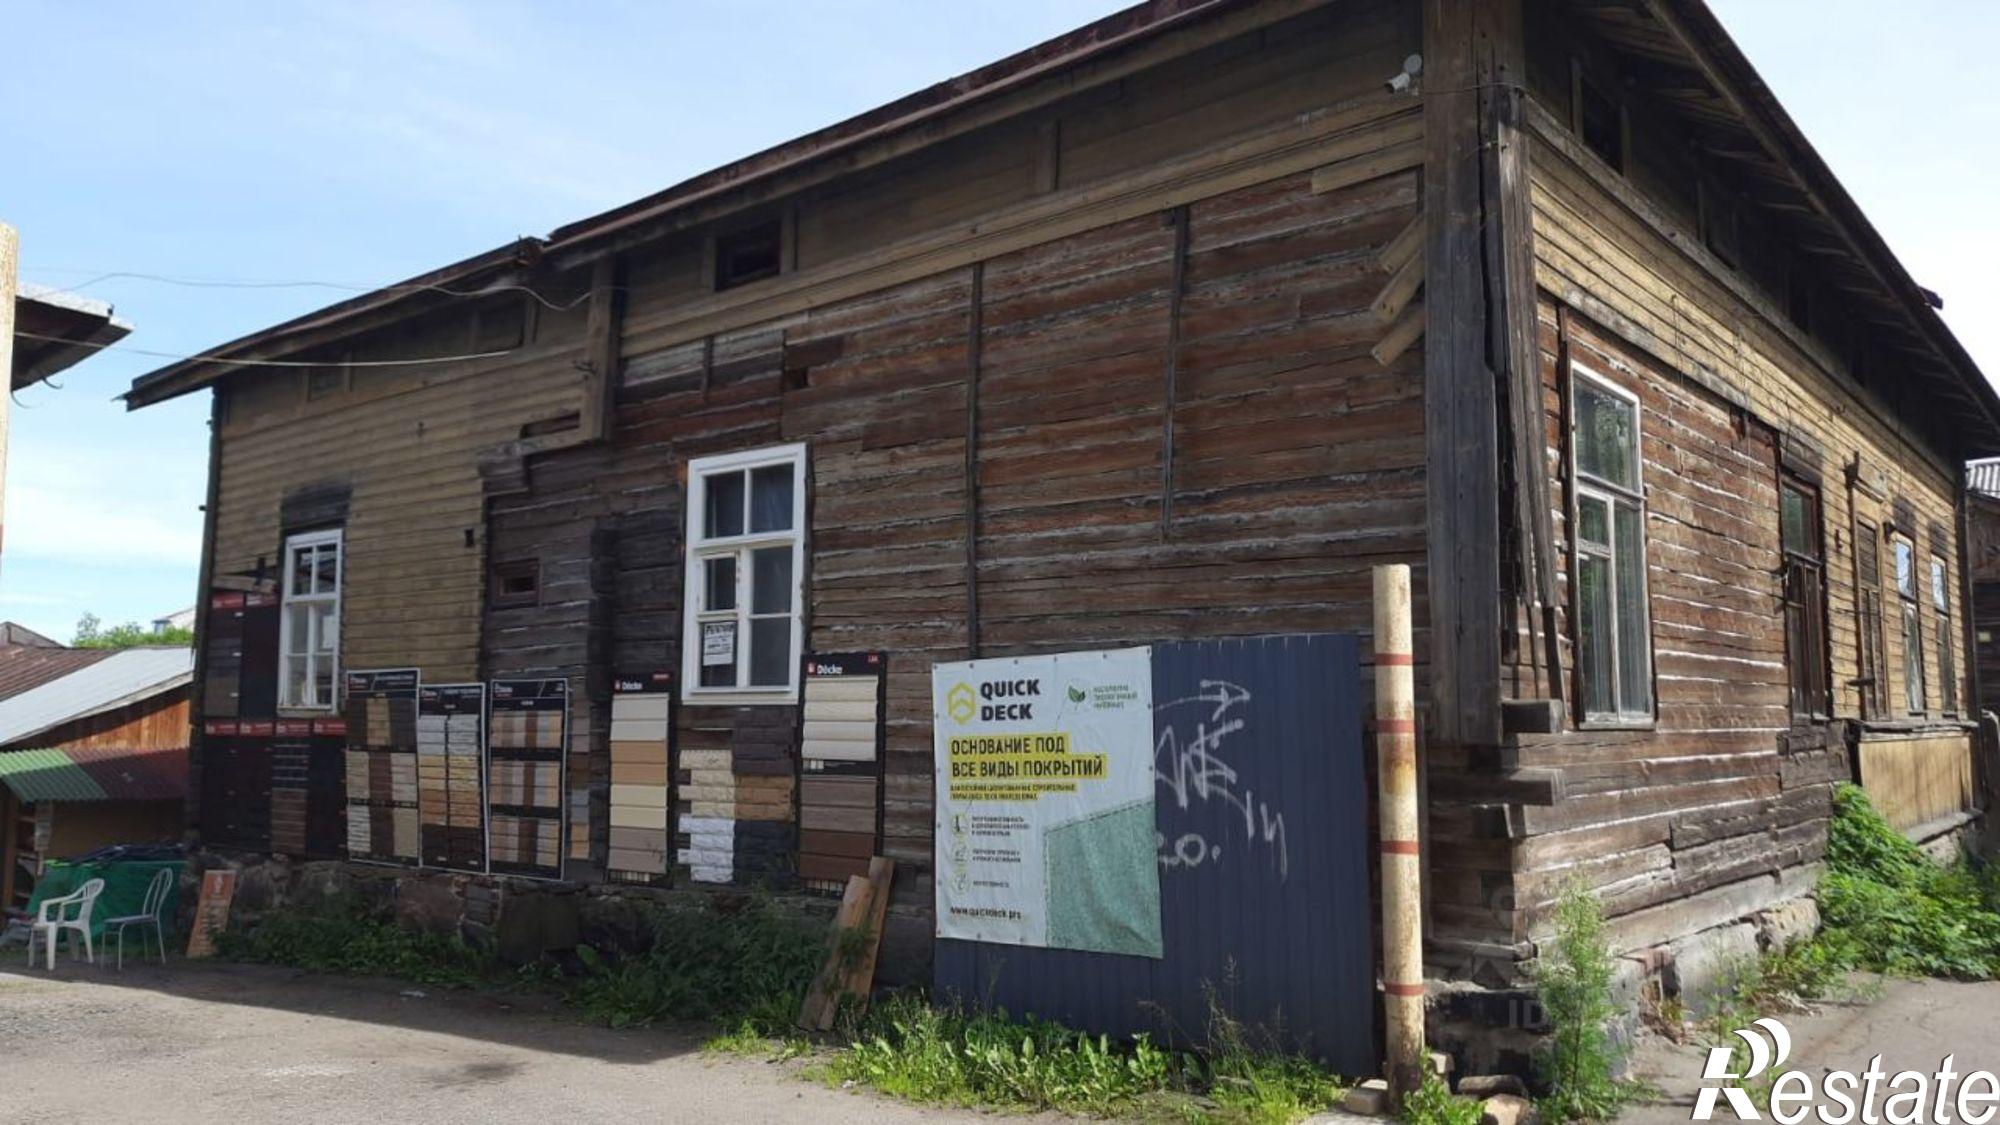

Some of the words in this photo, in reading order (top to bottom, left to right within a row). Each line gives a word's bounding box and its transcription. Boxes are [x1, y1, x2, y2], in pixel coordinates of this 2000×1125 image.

[980, 679, 1040, 700] QUICK
[981, 703, 1033, 721] DECK
[951, 737, 1031, 756] ОСНОВАНИЕ
[1036, 736, 1066, 755] ПОД
[952, 761, 976, 777] ВСЕ
[980, 760, 1018, 779] ВИДЫ
[1023, 755, 1103, 777] ПОКРЫТИЙ
